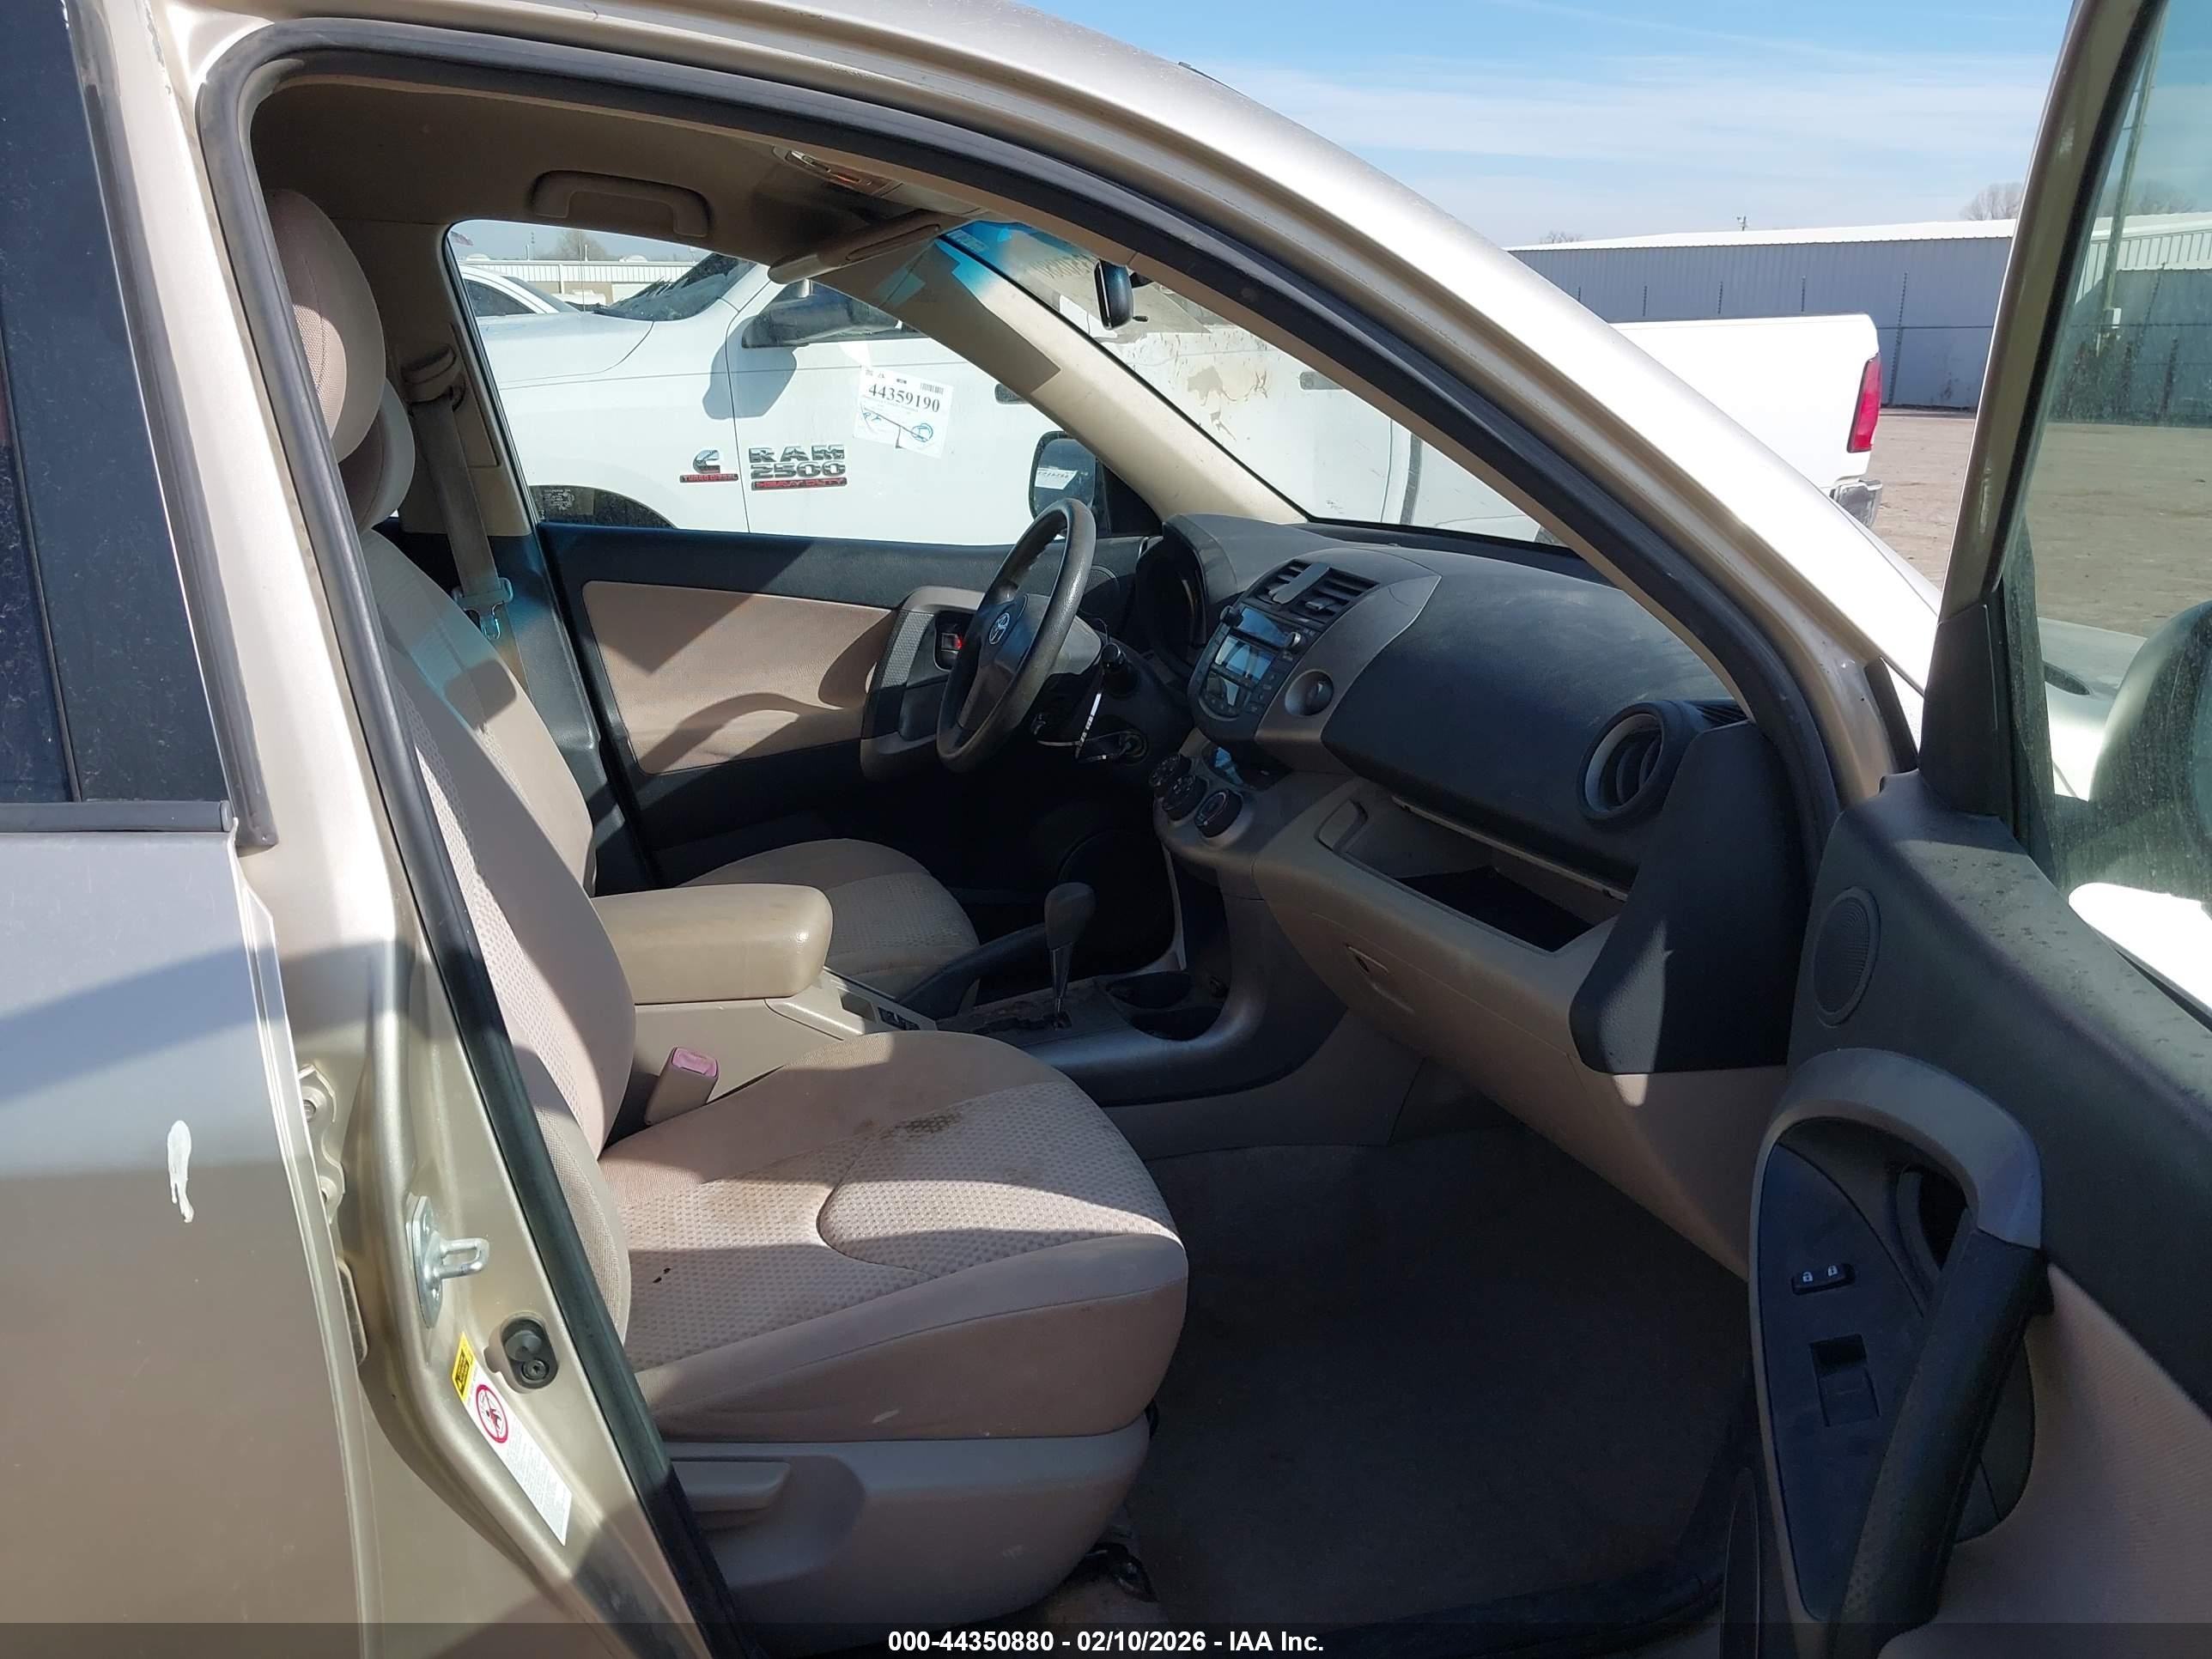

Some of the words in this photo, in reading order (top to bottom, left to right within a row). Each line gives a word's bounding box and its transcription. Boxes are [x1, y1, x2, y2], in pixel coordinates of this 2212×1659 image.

[869, 383, 940, 413] 44359190
[748, 444, 845, 463] RAM
[750, 461, 846, 479] 2500
